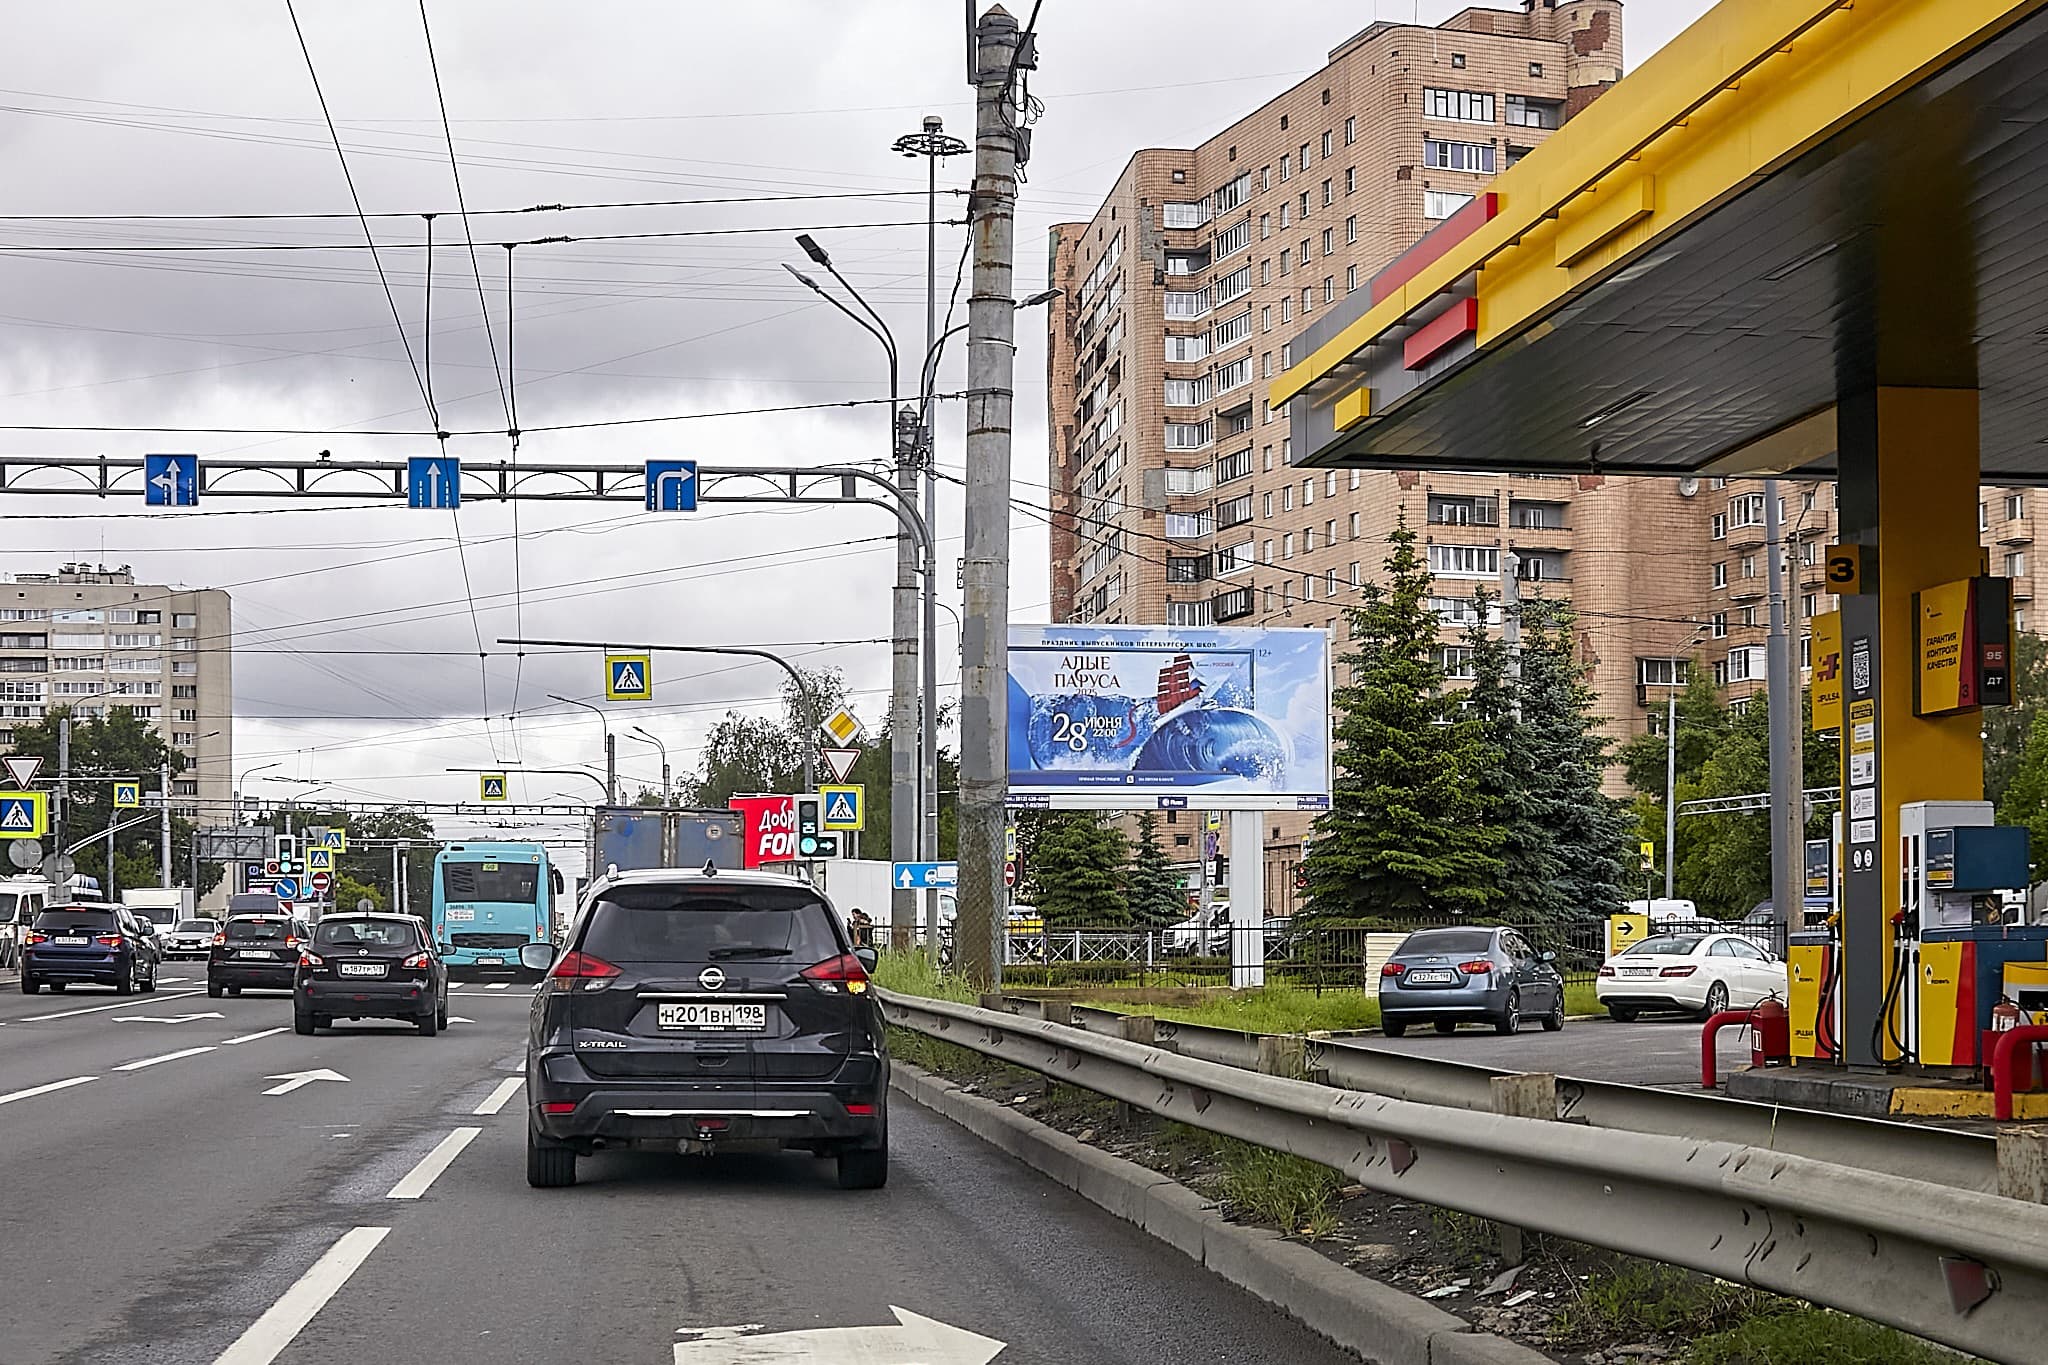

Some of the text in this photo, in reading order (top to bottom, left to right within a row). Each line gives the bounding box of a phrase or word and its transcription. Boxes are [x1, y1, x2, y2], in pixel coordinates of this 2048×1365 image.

[1829, 556, 1855, 583] 3
[1926, 632, 1957, 646] ГАРАНТИЯ
[1259, 649, 1272, 657] 12+
[1926, 644, 1958, 658] КОНТРОЛЯ
[1986, 651, 2002, 660] 95
[1061, 655, 1111, 671] АЛЫЕ
[1926, 657, 1957, 671] КАЧЕСТВА
[1054, 672, 1121, 688] ПАРУСА
[1987, 677, 2003, 685] ДТ
[1076, 688, 1098, 696] 2025
[1962, 683, 1969, 698] 3
[1053, 712, 1122, 751] 28 ИЮНЯ
[665, 1006, 761, 1023] Н201ВН 198
